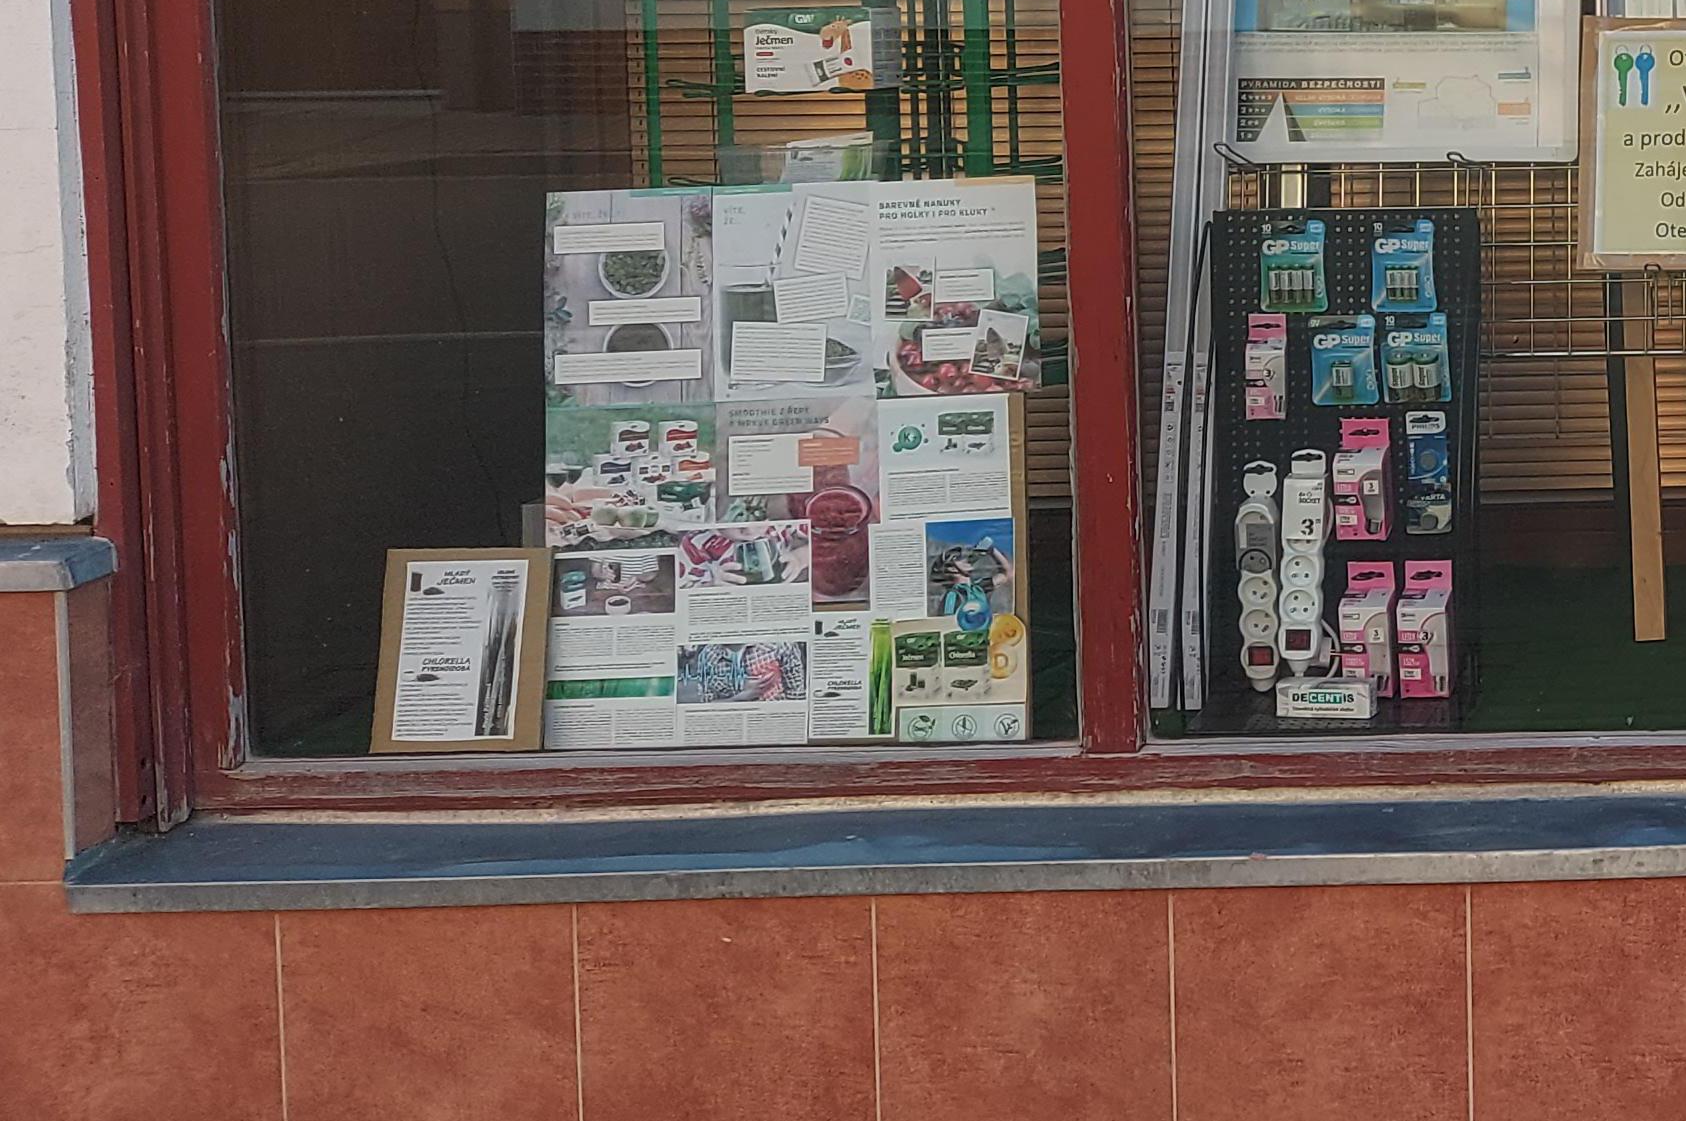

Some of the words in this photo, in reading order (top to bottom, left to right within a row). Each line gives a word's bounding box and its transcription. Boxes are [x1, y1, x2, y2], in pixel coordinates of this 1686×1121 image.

[755, 35, 794, 46] Ječmen
[1240, 79, 1298, 89] PYRAMIDA
[1300, 78, 1383, 89] BEZPEČNOSTI
[1623, 133, 1634, 147] a
[878, 199, 921, 210] BAREVNÉ
[923, 199, 961, 209] NANUKY
[1660, 192, 1686, 208] Od
[878, 211, 899, 220] PRO
[900, 210, 930, 219] HOLKY
[938, 209, 957, 218] PRO
[959, 208, 988, 217] KLUKY
[1261, 223, 1272, 233] 10
[1262, 239, 1290, 255] GP
[1290, 240, 1320, 252] Super
[1374, 238, 1402, 254] GP
[1401, 239, 1430, 252] Super
[1384, 316, 1396, 326] 10
[1313, 334, 1341, 349] GP
[1341, 334, 1371, 345] Super
[1387, 332, 1413, 347] GP
[1413, 331, 1441, 343] Super
[436, 576, 476, 586] JEČMEN
[422, 658, 471, 666] CHLORELLA
[1292, 692, 1355, 703] DECENTIS
